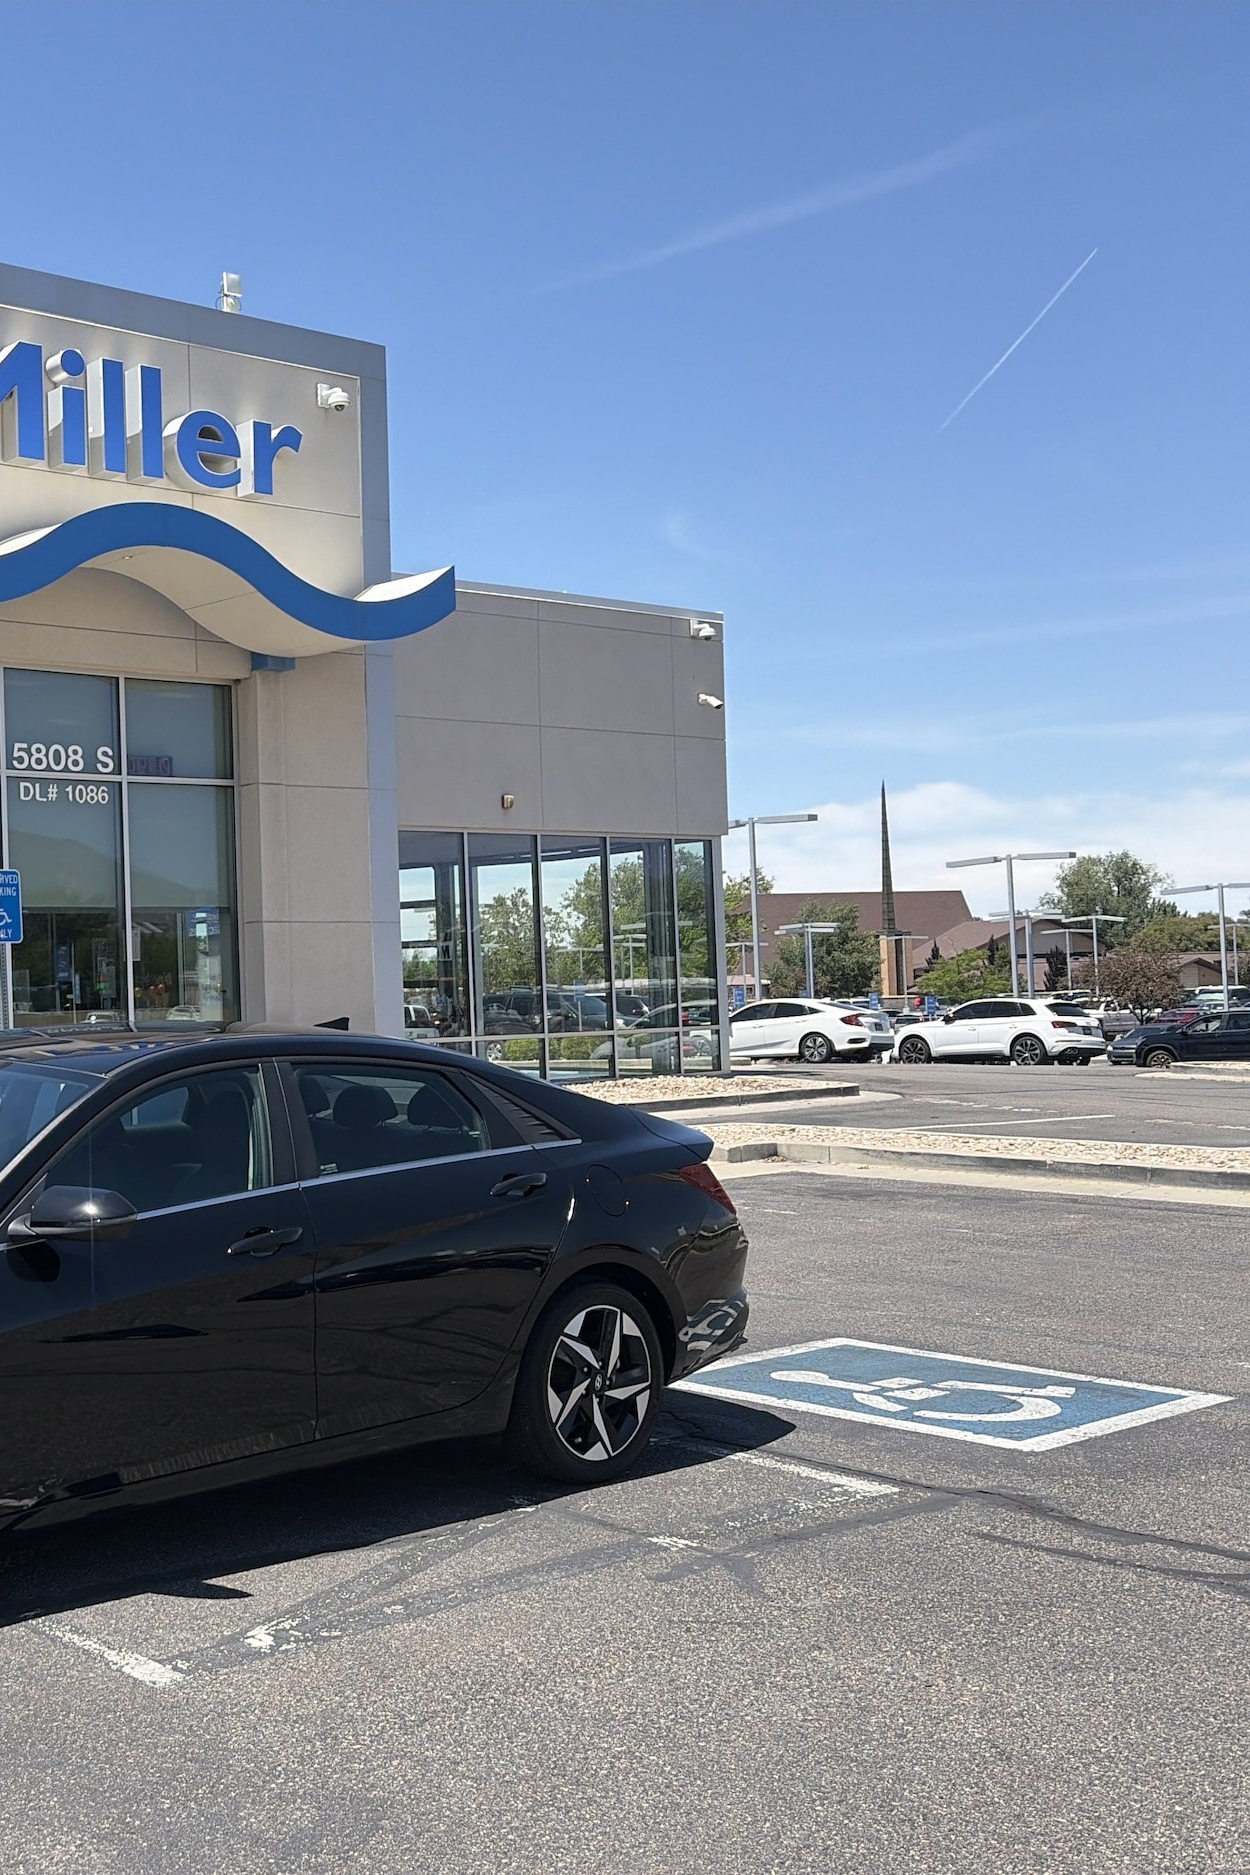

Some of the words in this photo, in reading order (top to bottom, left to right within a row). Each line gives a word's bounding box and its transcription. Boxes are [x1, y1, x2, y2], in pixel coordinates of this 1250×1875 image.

[12, 742, 85, 772] 5808
[96, 746, 114, 773] S
[19, 781, 58, 801] DL#
[65, 784, 109, 804] 1086
